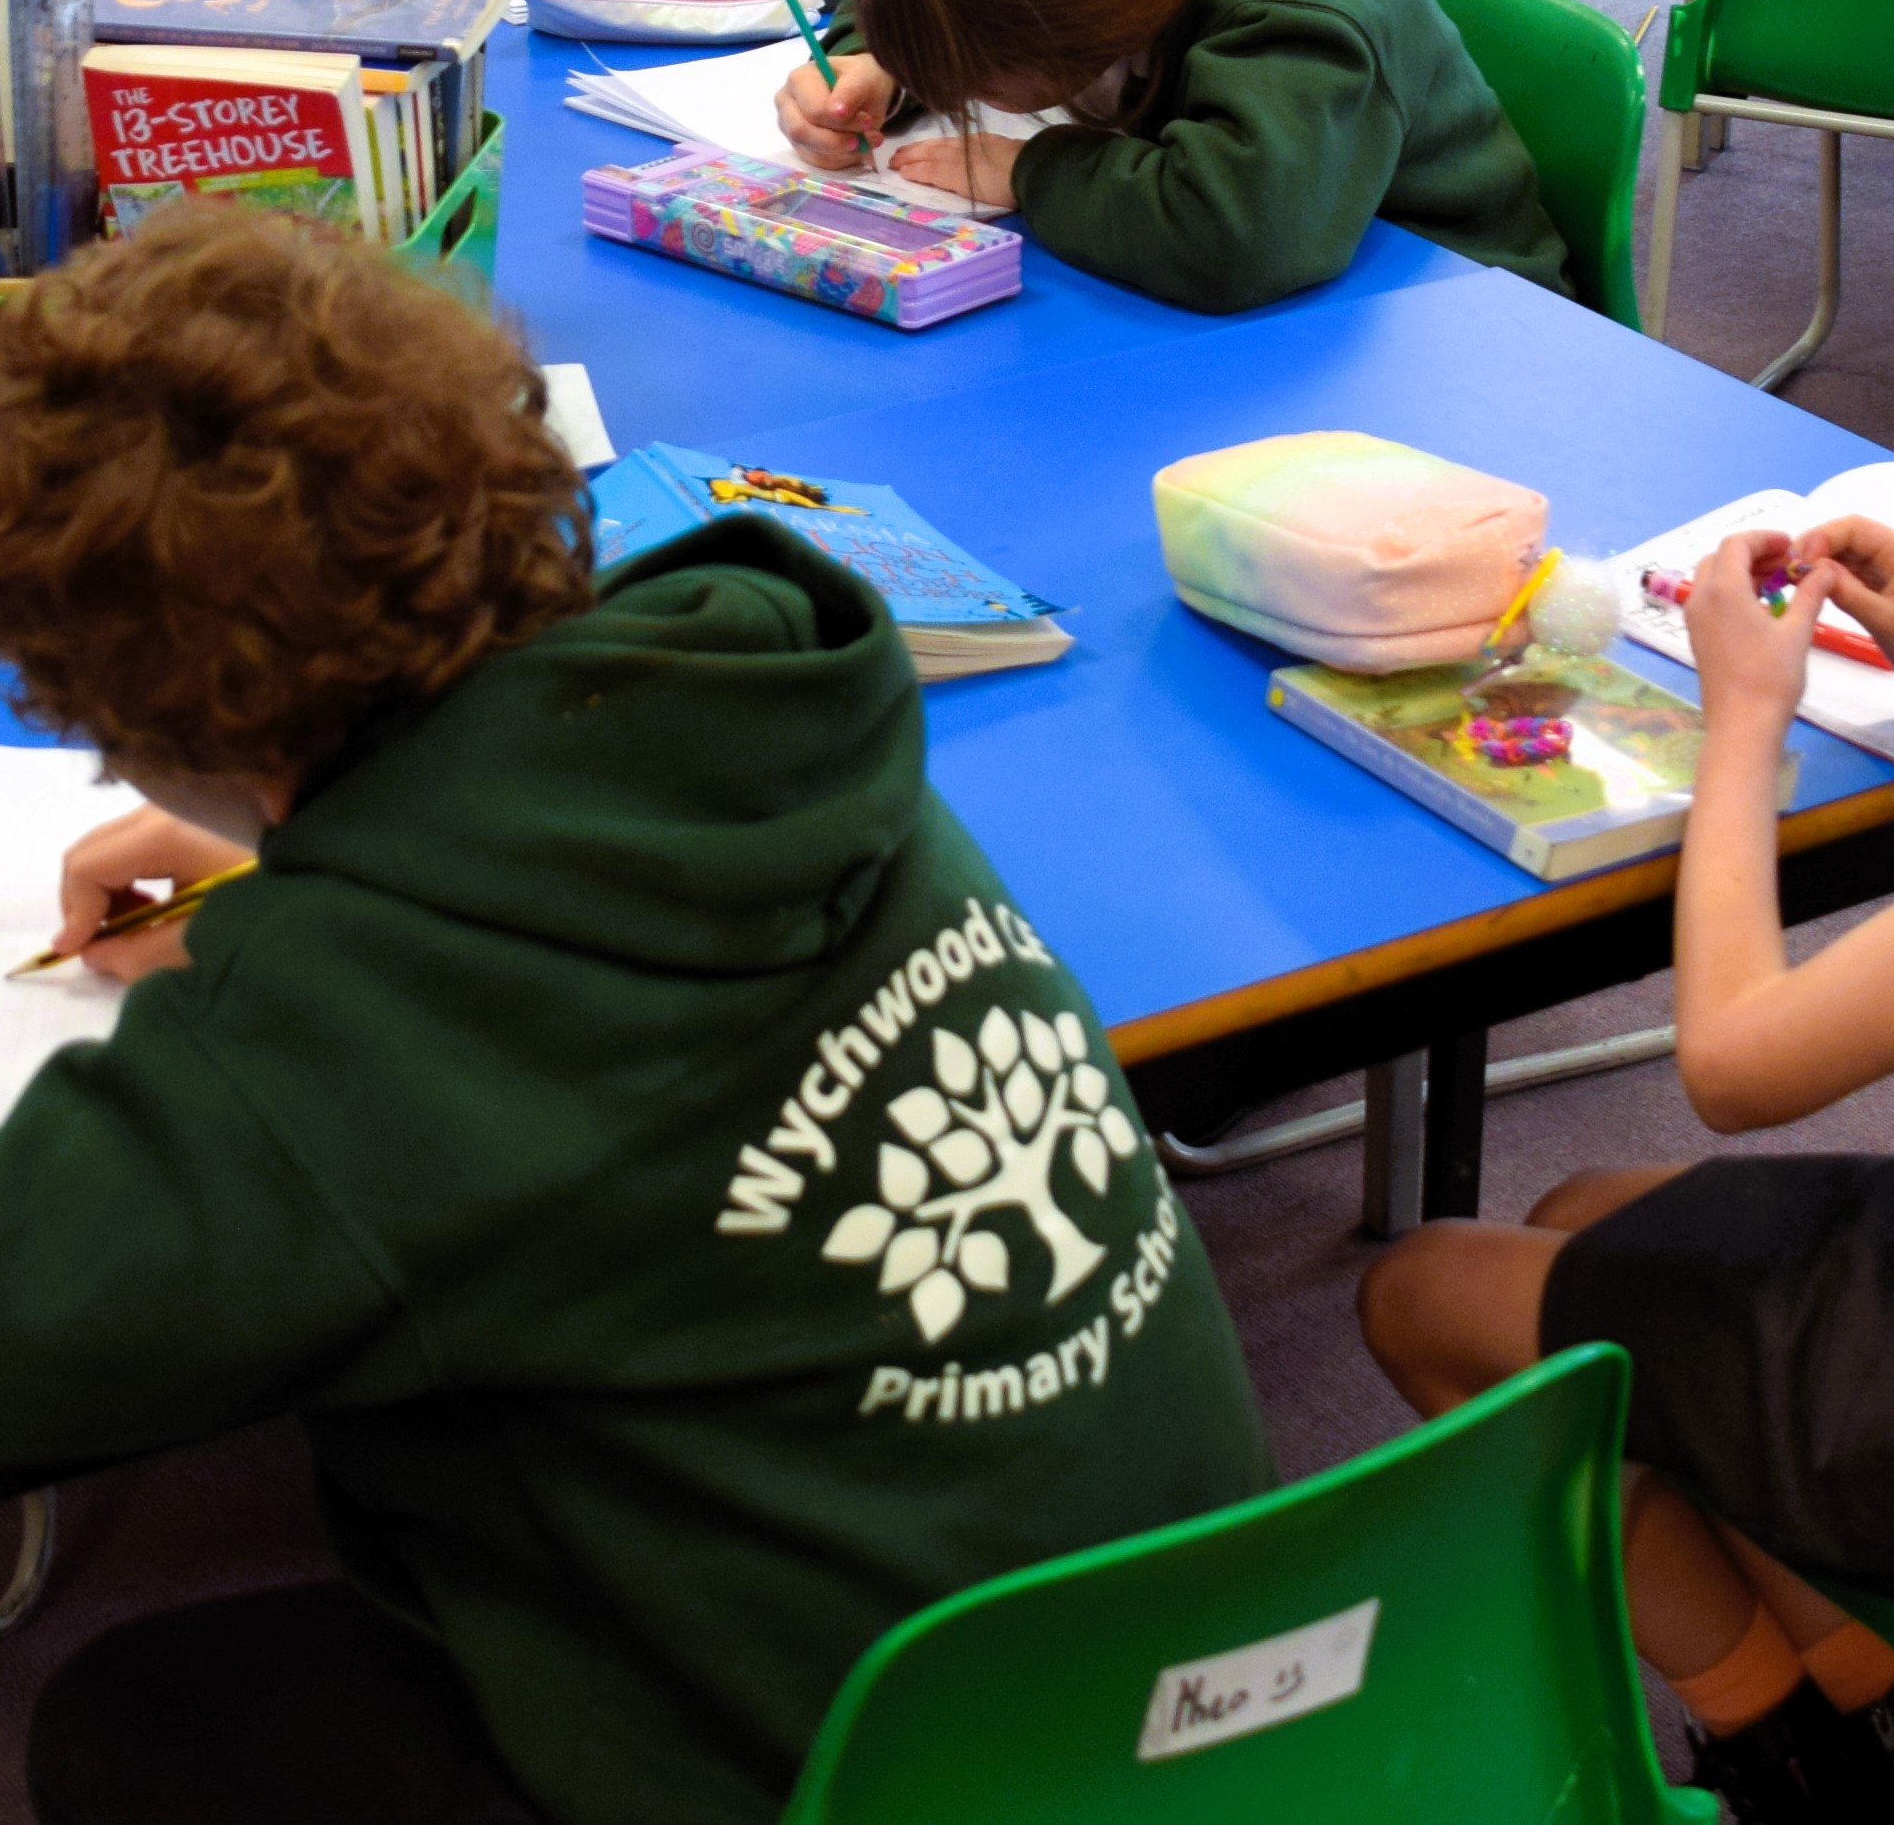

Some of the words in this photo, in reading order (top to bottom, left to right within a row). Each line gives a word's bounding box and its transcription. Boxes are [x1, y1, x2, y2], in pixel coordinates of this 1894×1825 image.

[112, 86, 153, 107] THE
[112, 93, 299, 143] 13-STOREY
[110, 128, 333, 178] TREEHOUSE
[715, 897, 1008, 1234] Wychwood
[859, 1316, 1108, 1422] Primary
[1110, 1164, 1178, 1338] Scho
